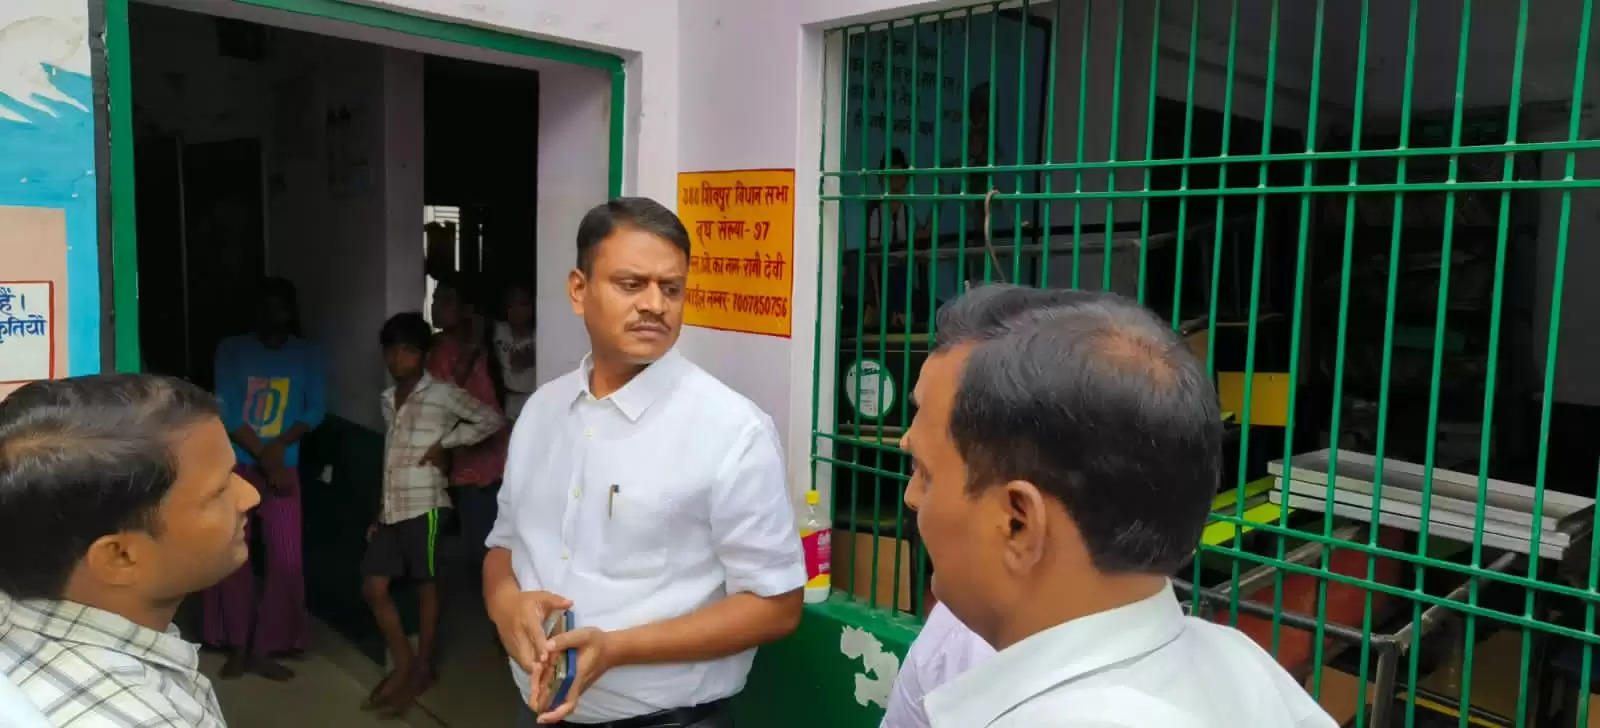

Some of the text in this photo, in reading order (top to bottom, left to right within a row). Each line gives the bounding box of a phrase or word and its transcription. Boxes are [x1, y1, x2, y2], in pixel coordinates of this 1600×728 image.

[701, 181, 731, 212] शिवपुर
[735, 181, 762, 205] विधान
[765, 185, 789, 206] सभा
[764, 252, 786, 280] देवी
